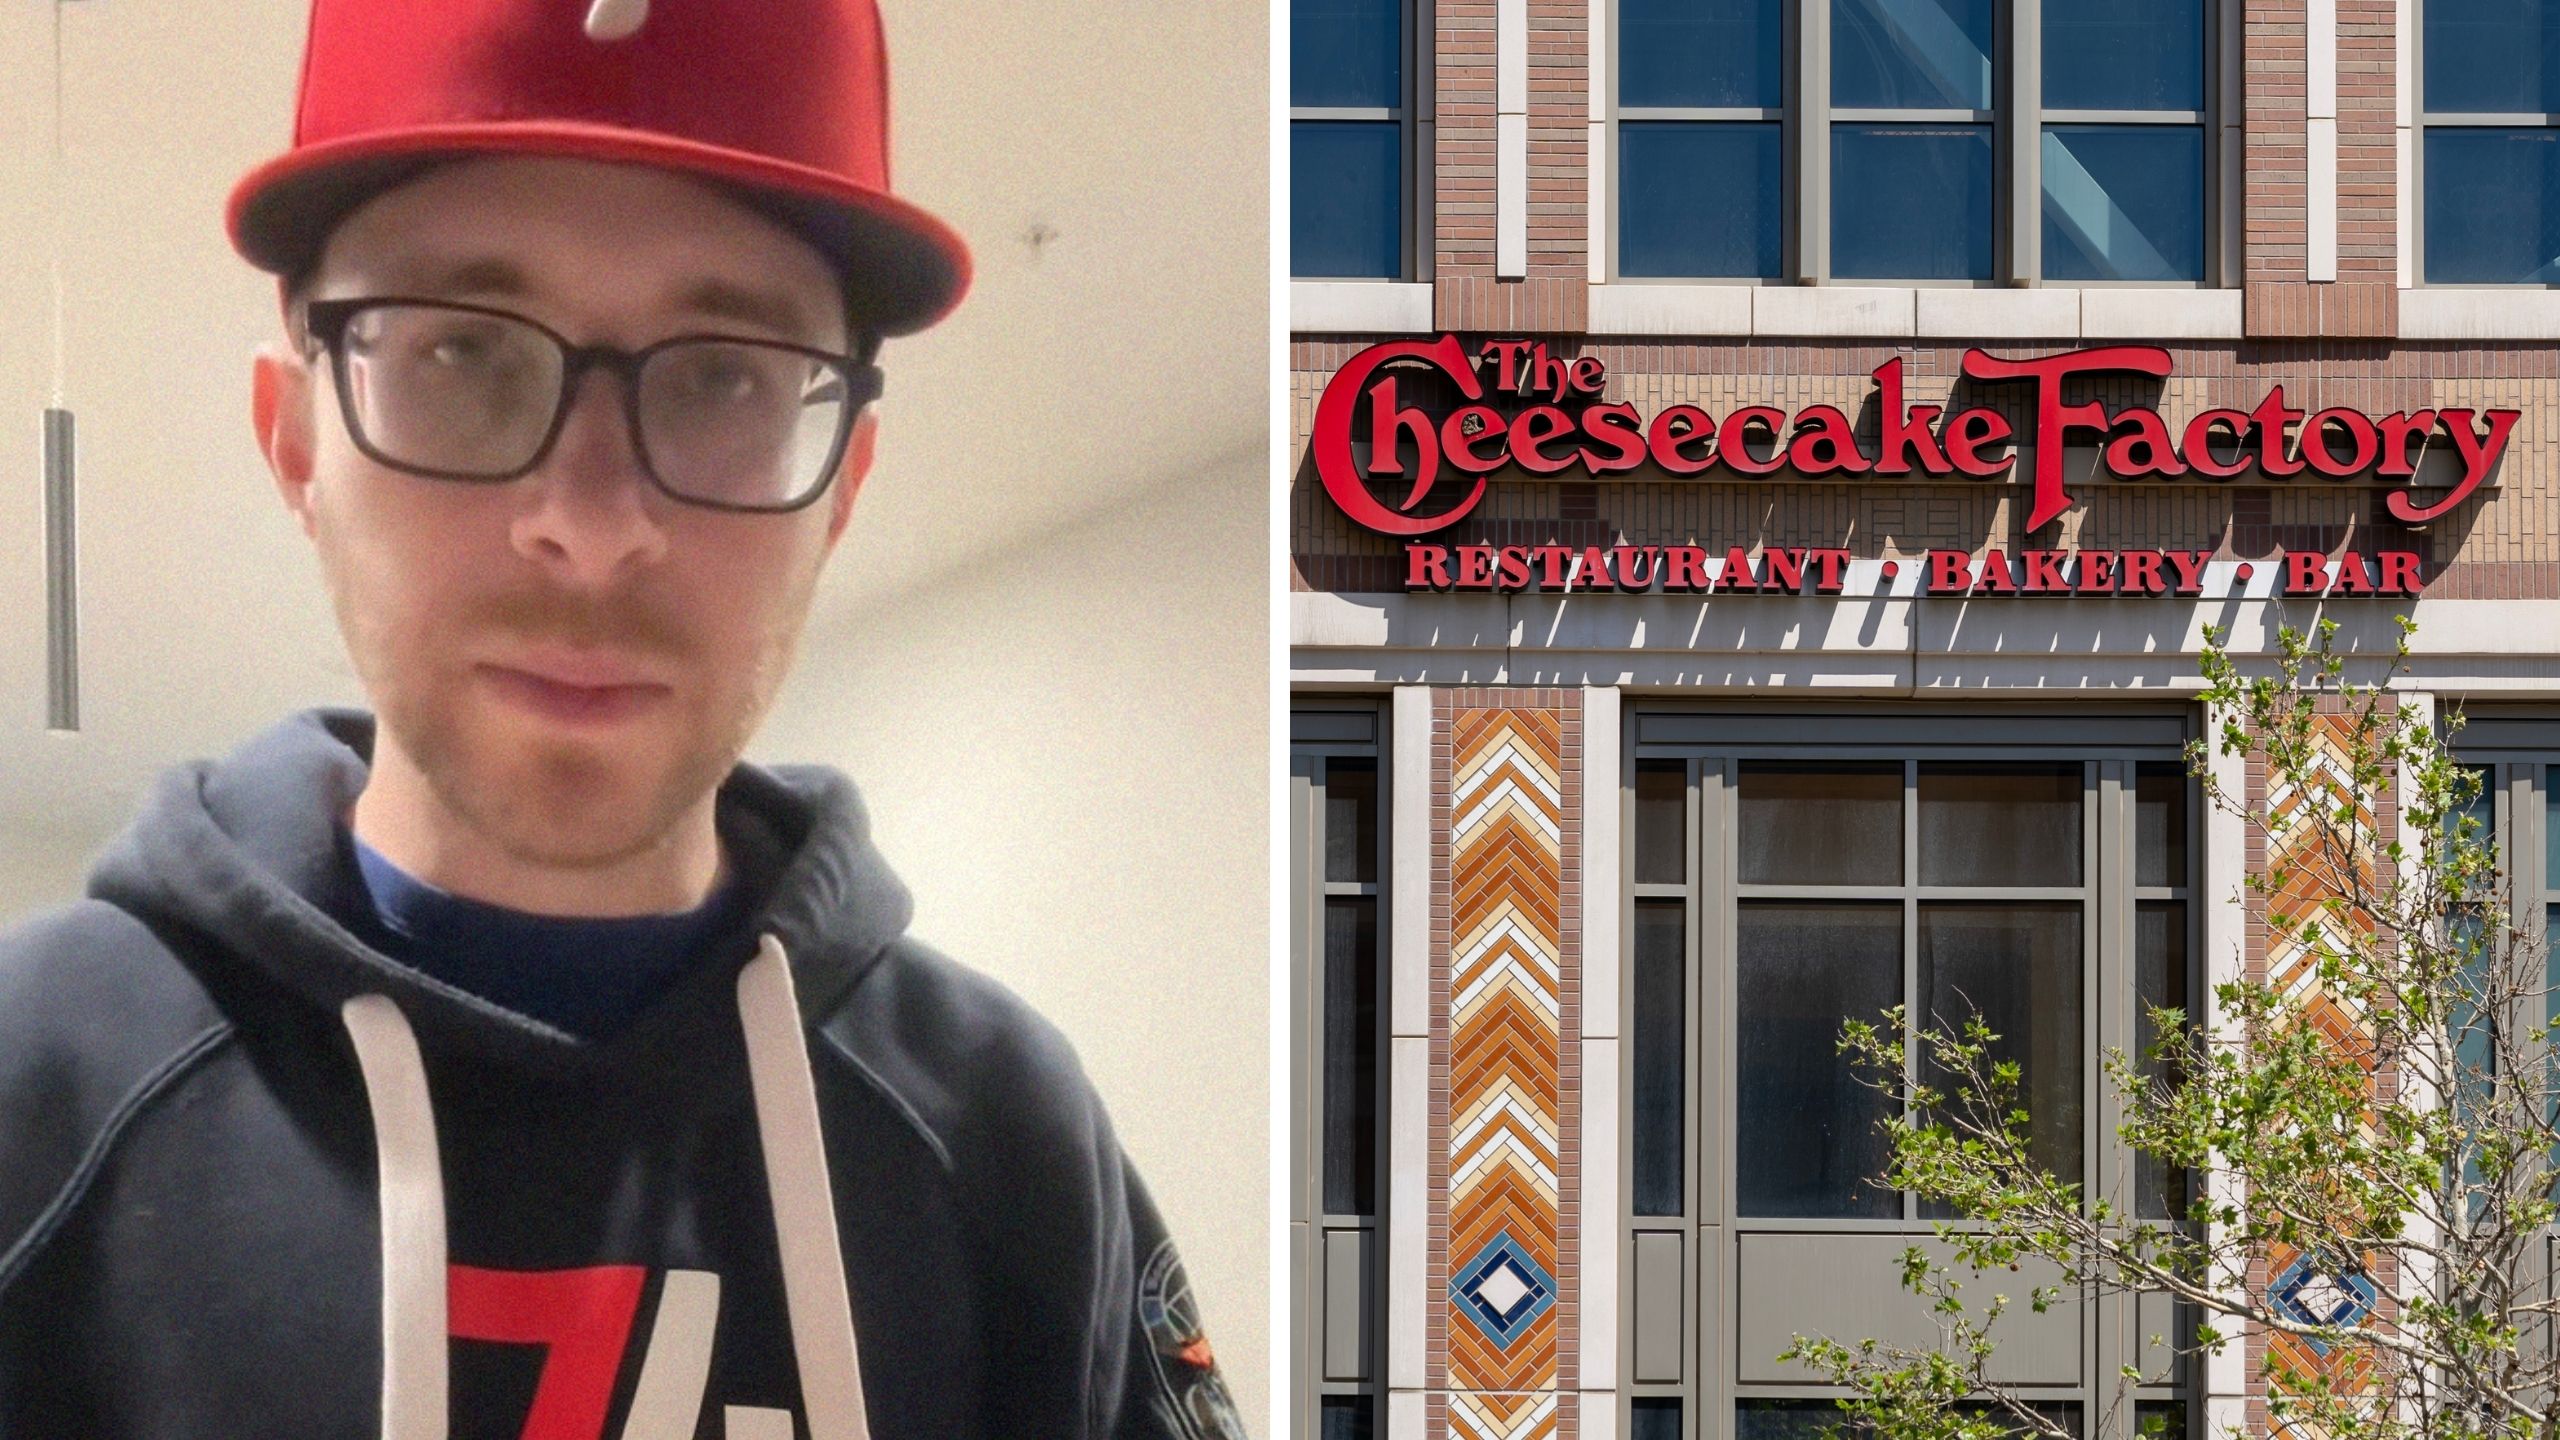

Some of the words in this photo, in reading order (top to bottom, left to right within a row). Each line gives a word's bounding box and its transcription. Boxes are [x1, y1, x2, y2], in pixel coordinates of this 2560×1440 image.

[1483, 338, 1607, 403] The
[1312, 333, 2015, 536] Cheesecake
[1961, 345, 2522, 534] Factory
[1404, 543, 1851, 594] RESTAURANT
[1927, 549, 2213, 597] BAKERY
[2284, 551, 2427, 597] BAR
